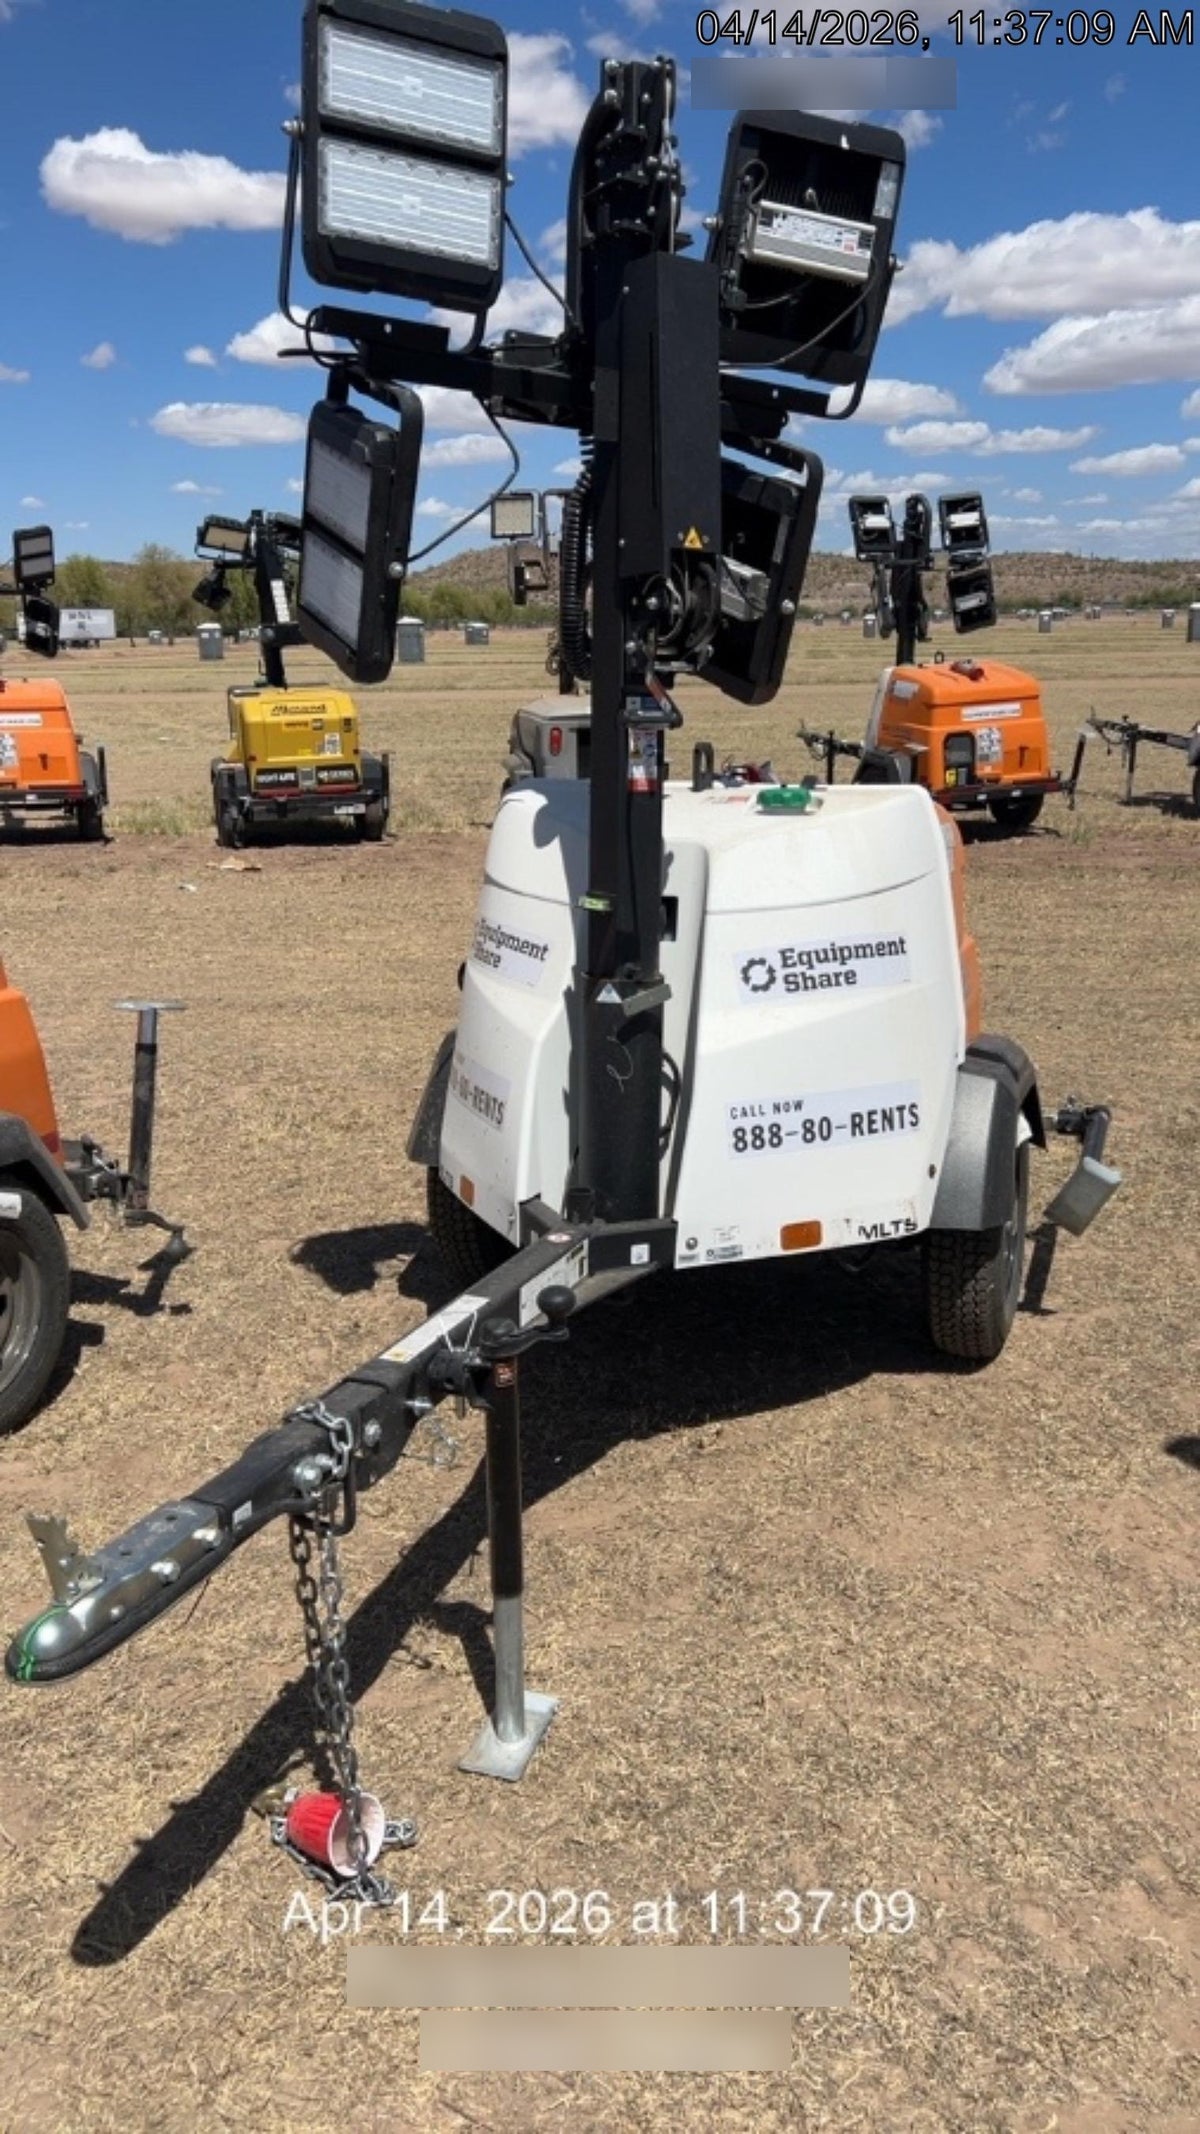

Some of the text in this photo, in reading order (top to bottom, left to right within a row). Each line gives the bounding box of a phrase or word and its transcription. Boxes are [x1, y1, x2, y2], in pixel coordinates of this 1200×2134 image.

[778, 936, 907, 970] Equipment
[782, 968, 858, 993] Share
[729, 1099, 805, 1120] CALL NOW
[732, 1102, 920, 1153] 888-80-RENTS
